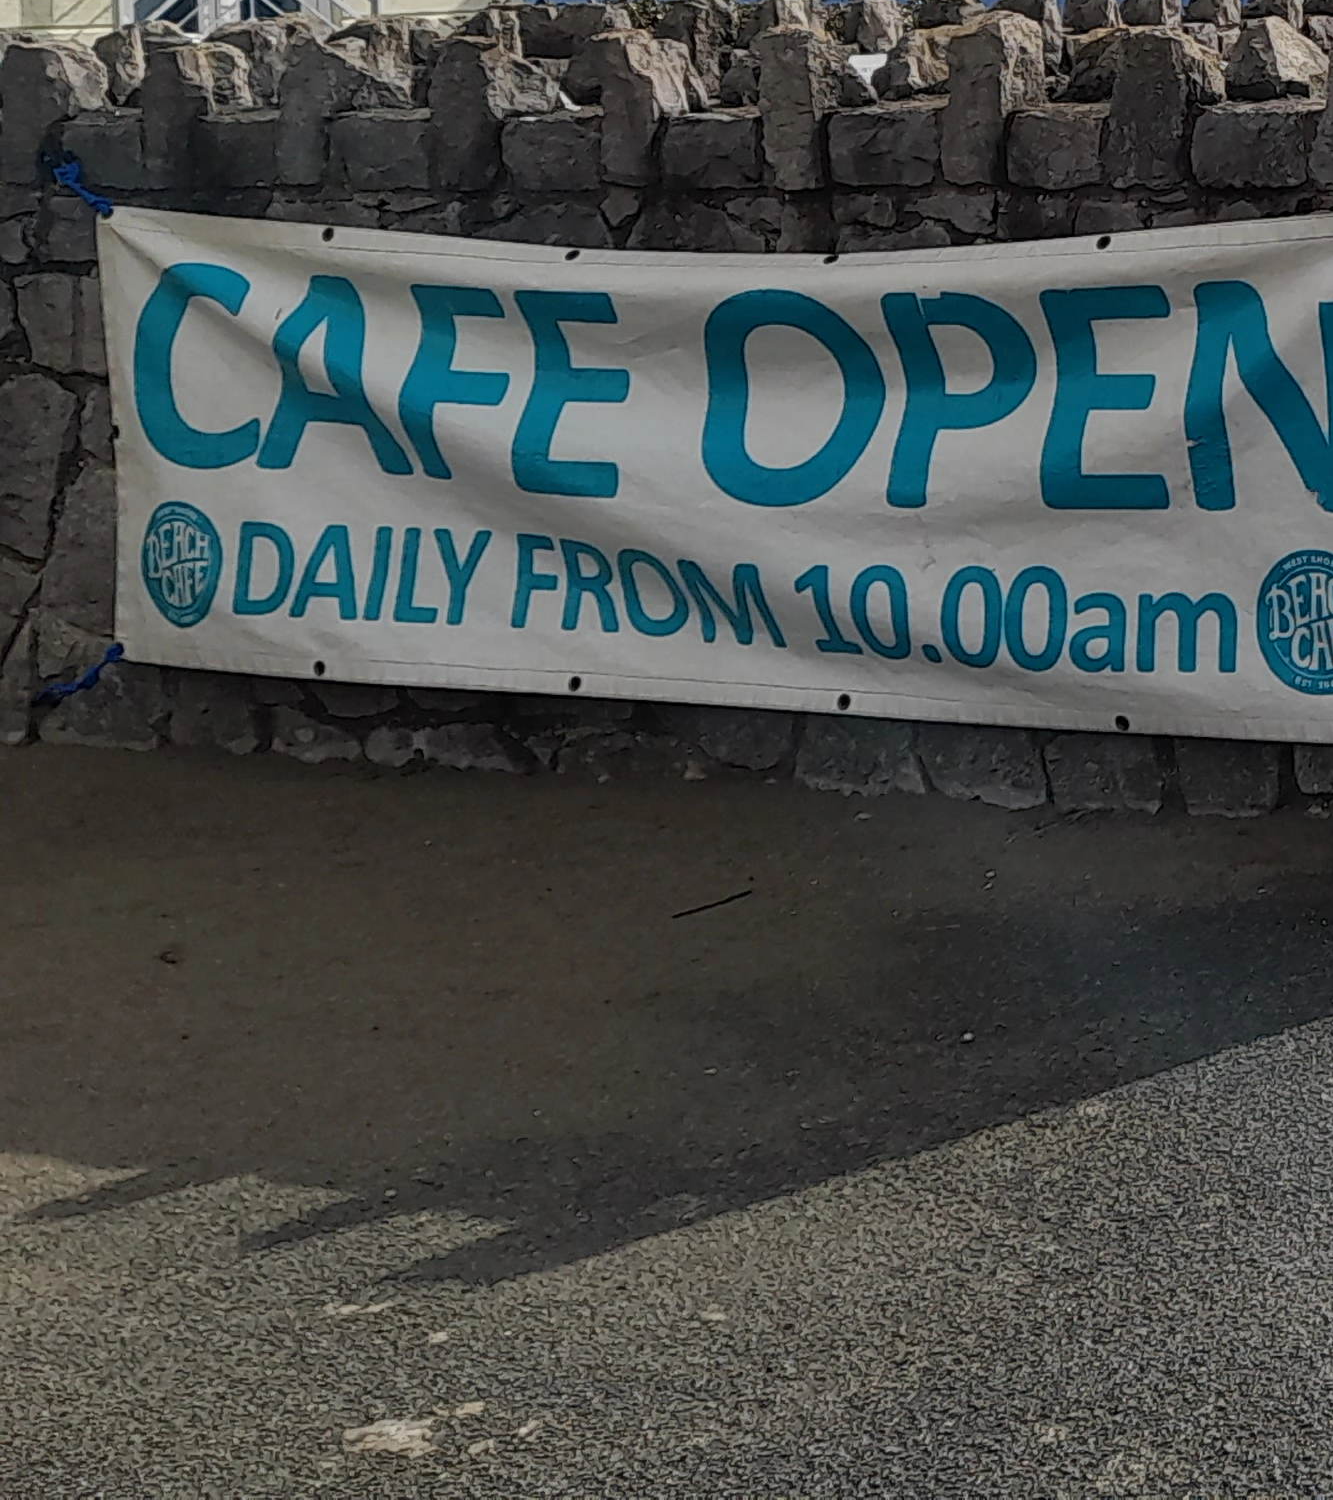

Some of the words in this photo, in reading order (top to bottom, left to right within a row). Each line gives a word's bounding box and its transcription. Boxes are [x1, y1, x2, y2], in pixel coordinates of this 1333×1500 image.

[133, 262, 631, 498] CAFE
[145, 520, 211, 579] BEACH
[161, 559, 210, 607] CAFE
[232, 521, 493, 625] DAILY
[511, 533, 787, 648] FROM
[794, 564, 1239, 674] 10.00am
